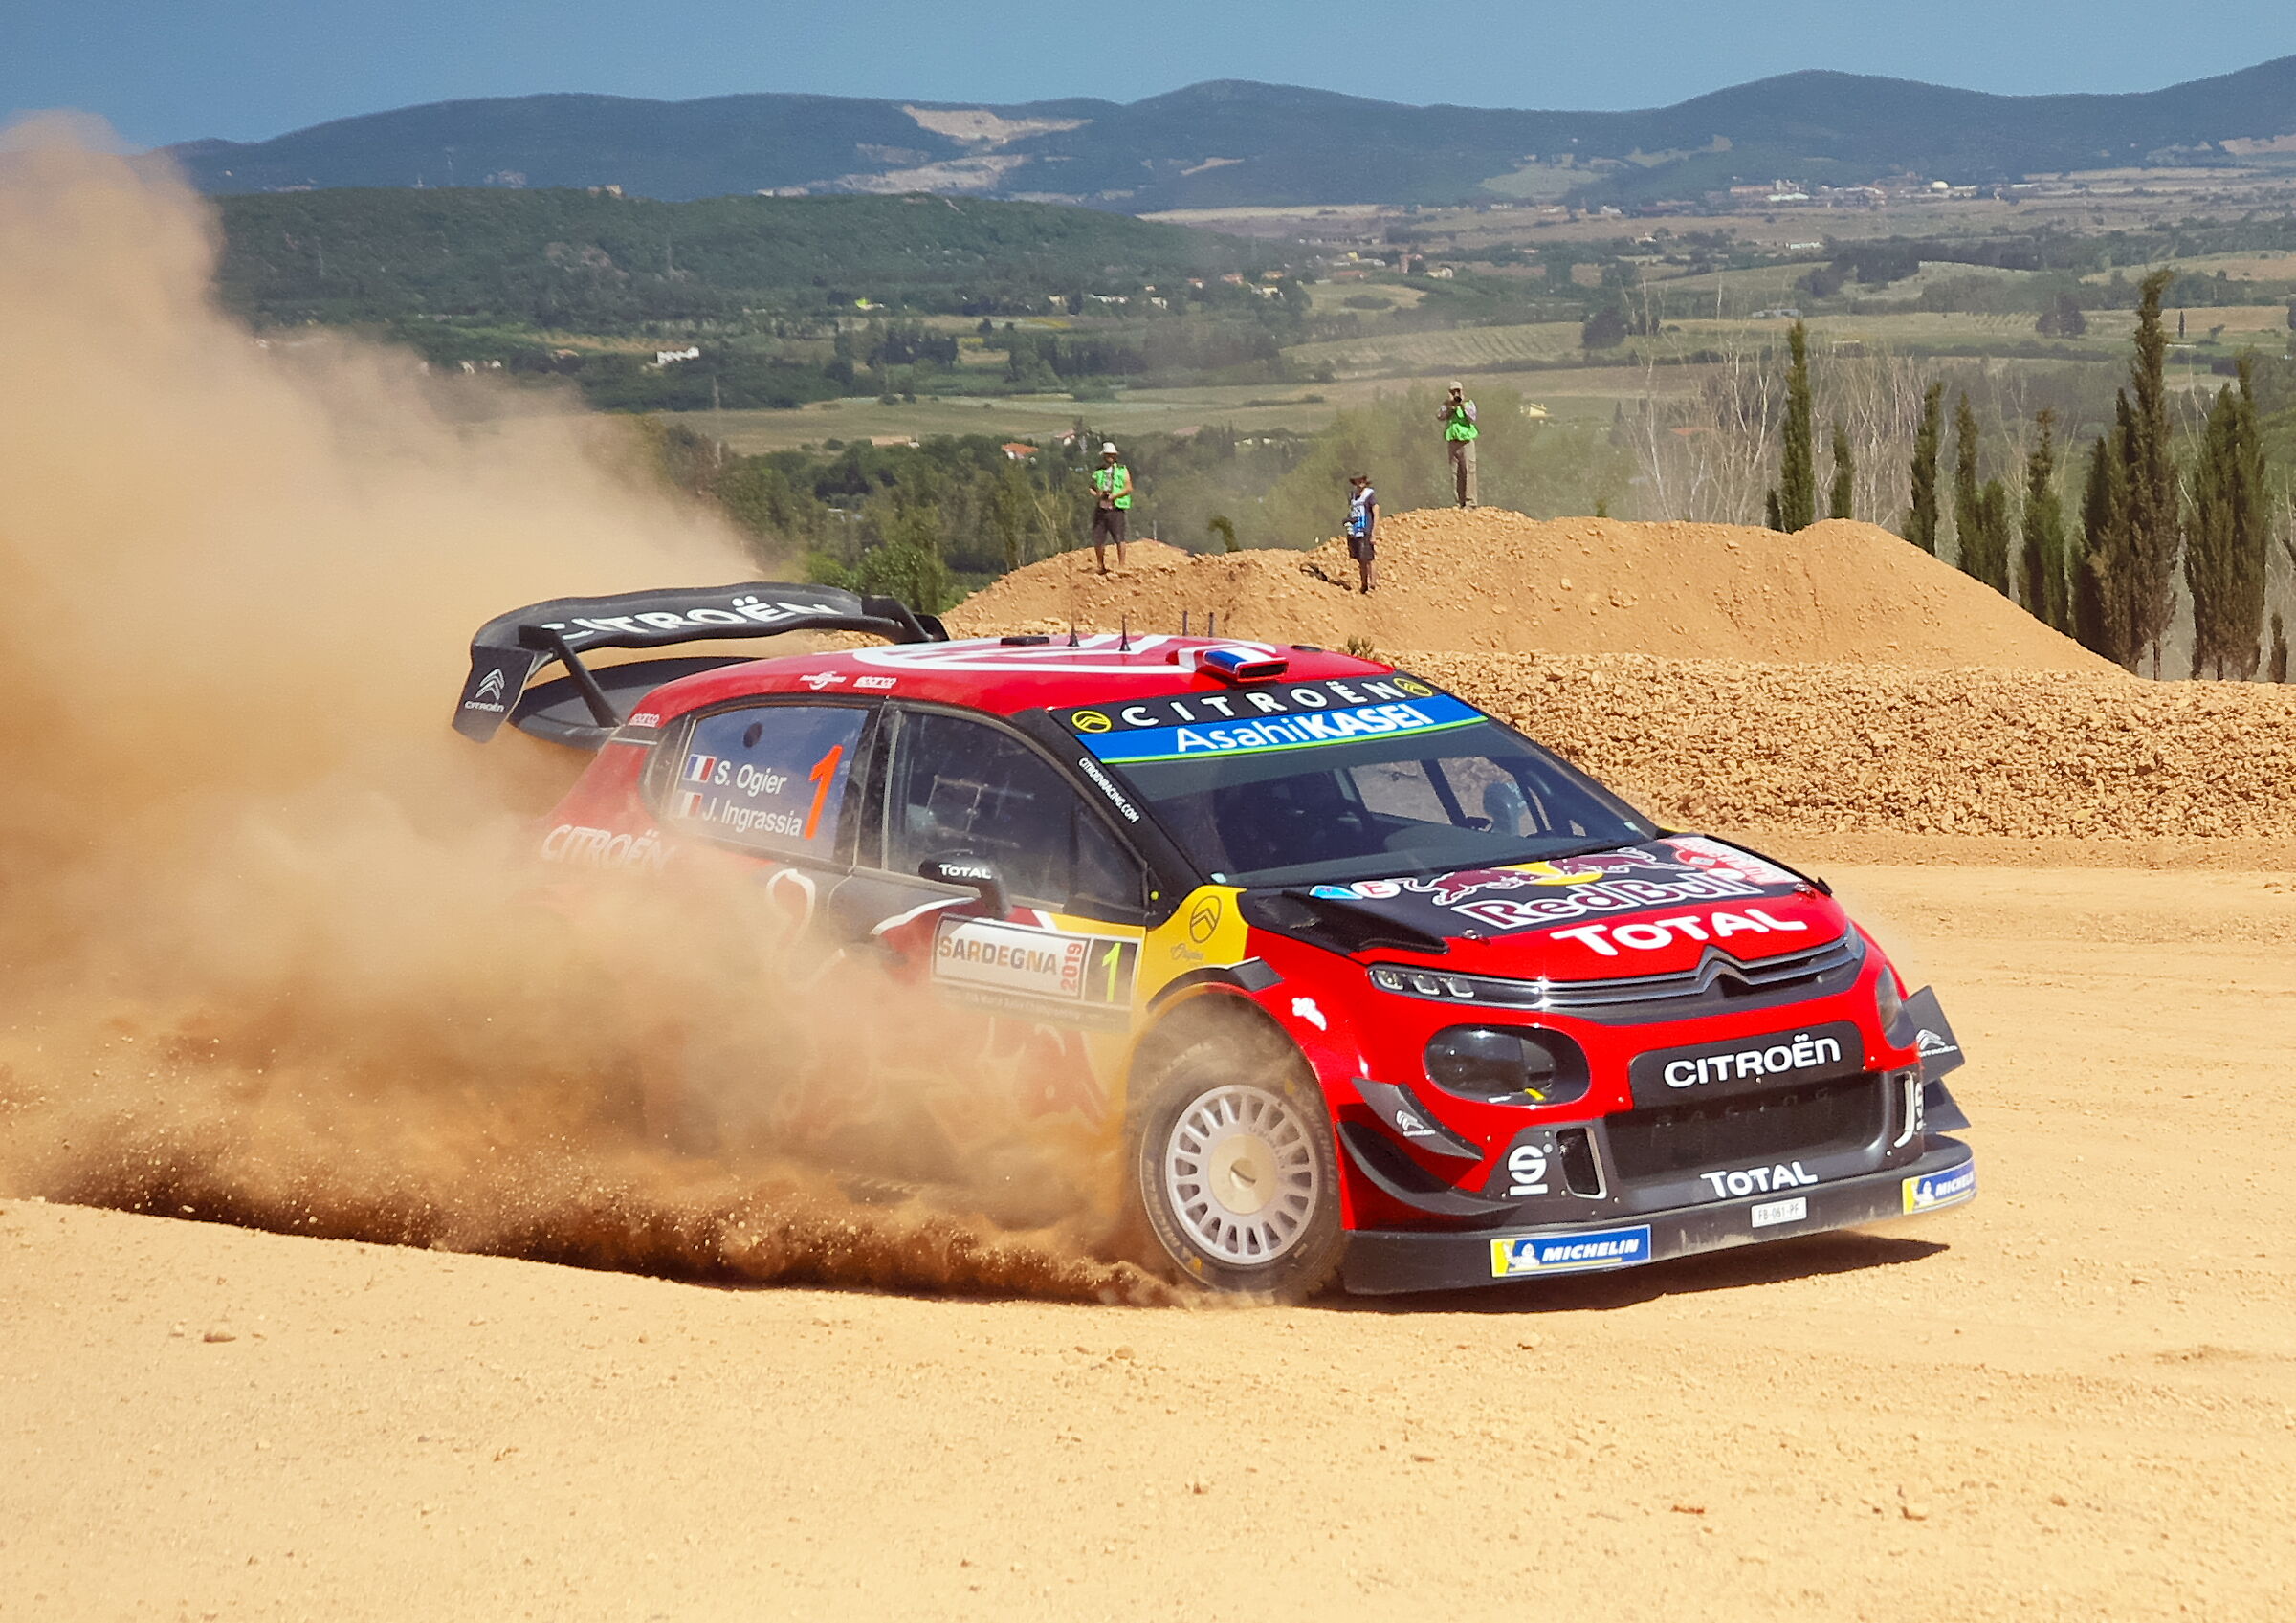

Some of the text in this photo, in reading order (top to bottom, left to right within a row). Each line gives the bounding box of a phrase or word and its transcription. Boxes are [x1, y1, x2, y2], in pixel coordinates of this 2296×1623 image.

[1120, 680, 1405, 728] CITROËN
[714, 760, 787, 797] S. Ogier
[804, 744, 844, 840] 1
[703, 797, 803, 838] J. Ingrassia
[541, 824, 677, 872] CITROËN
[938, 864, 992, 880] TOTAL
[938, 935, 1057, 976] SARDEGNA
[1550, 909, 1808, 956] TOTAL
[1059, 943, 1083, 992] 2019
[1101, 941, 1122, 1003] 1
[1663, 1033, 1842, 1088] CITROËN
[1700, 1161, 1818, 1197] TOTAL
[1542, 1239, 1640, 1262] MICHELIN
